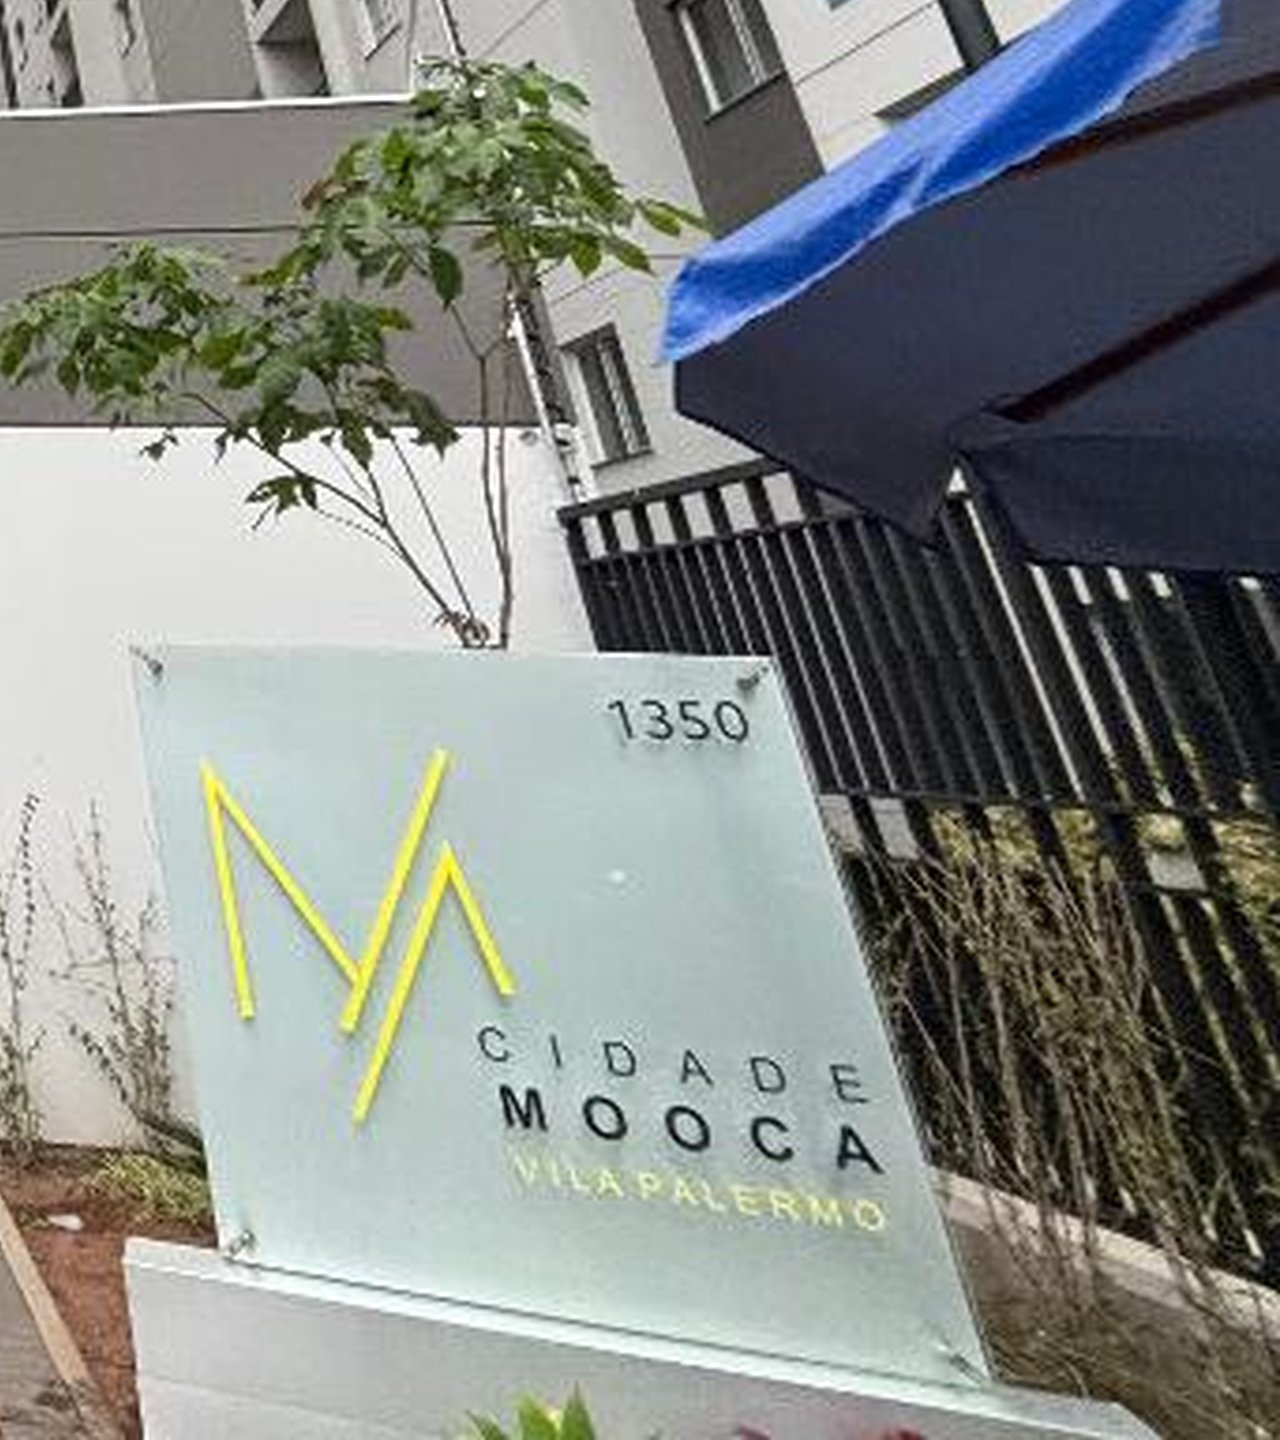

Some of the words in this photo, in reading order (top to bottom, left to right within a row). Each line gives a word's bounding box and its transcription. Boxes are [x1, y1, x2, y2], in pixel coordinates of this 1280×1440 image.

[608, 700, 749, 743] 1350
[476, 1026, 868, 1104] CIDADE
[498, 1083, 886, 1175] MOOCA
[514, 1156, 624, 1199] VILA
[638, 1172, 886, 1232] PALERMO
